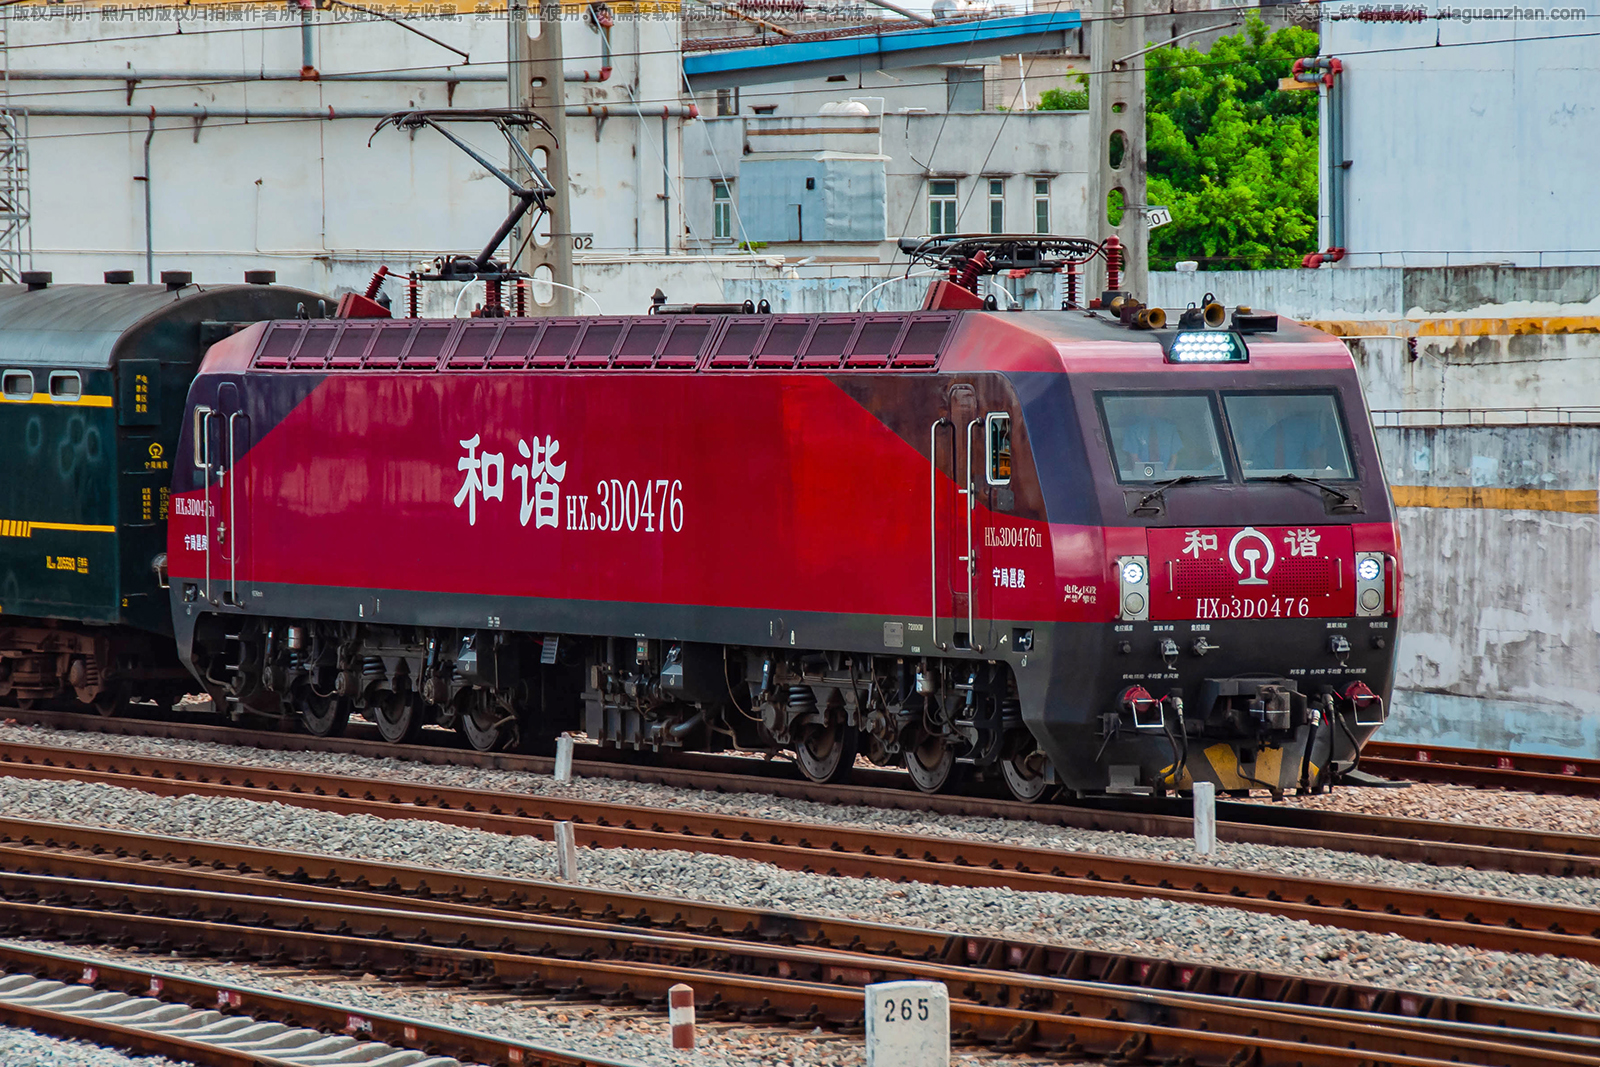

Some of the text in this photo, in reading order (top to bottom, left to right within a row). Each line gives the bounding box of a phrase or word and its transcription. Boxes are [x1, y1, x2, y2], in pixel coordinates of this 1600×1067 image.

[571, 237, 593, 249] 02
[453, 433, 684, 532] 和谐 HXD3D0476
[1196, 597, 1310, 619] HXD3D0476
[884, 998, 929, 1022] 265
